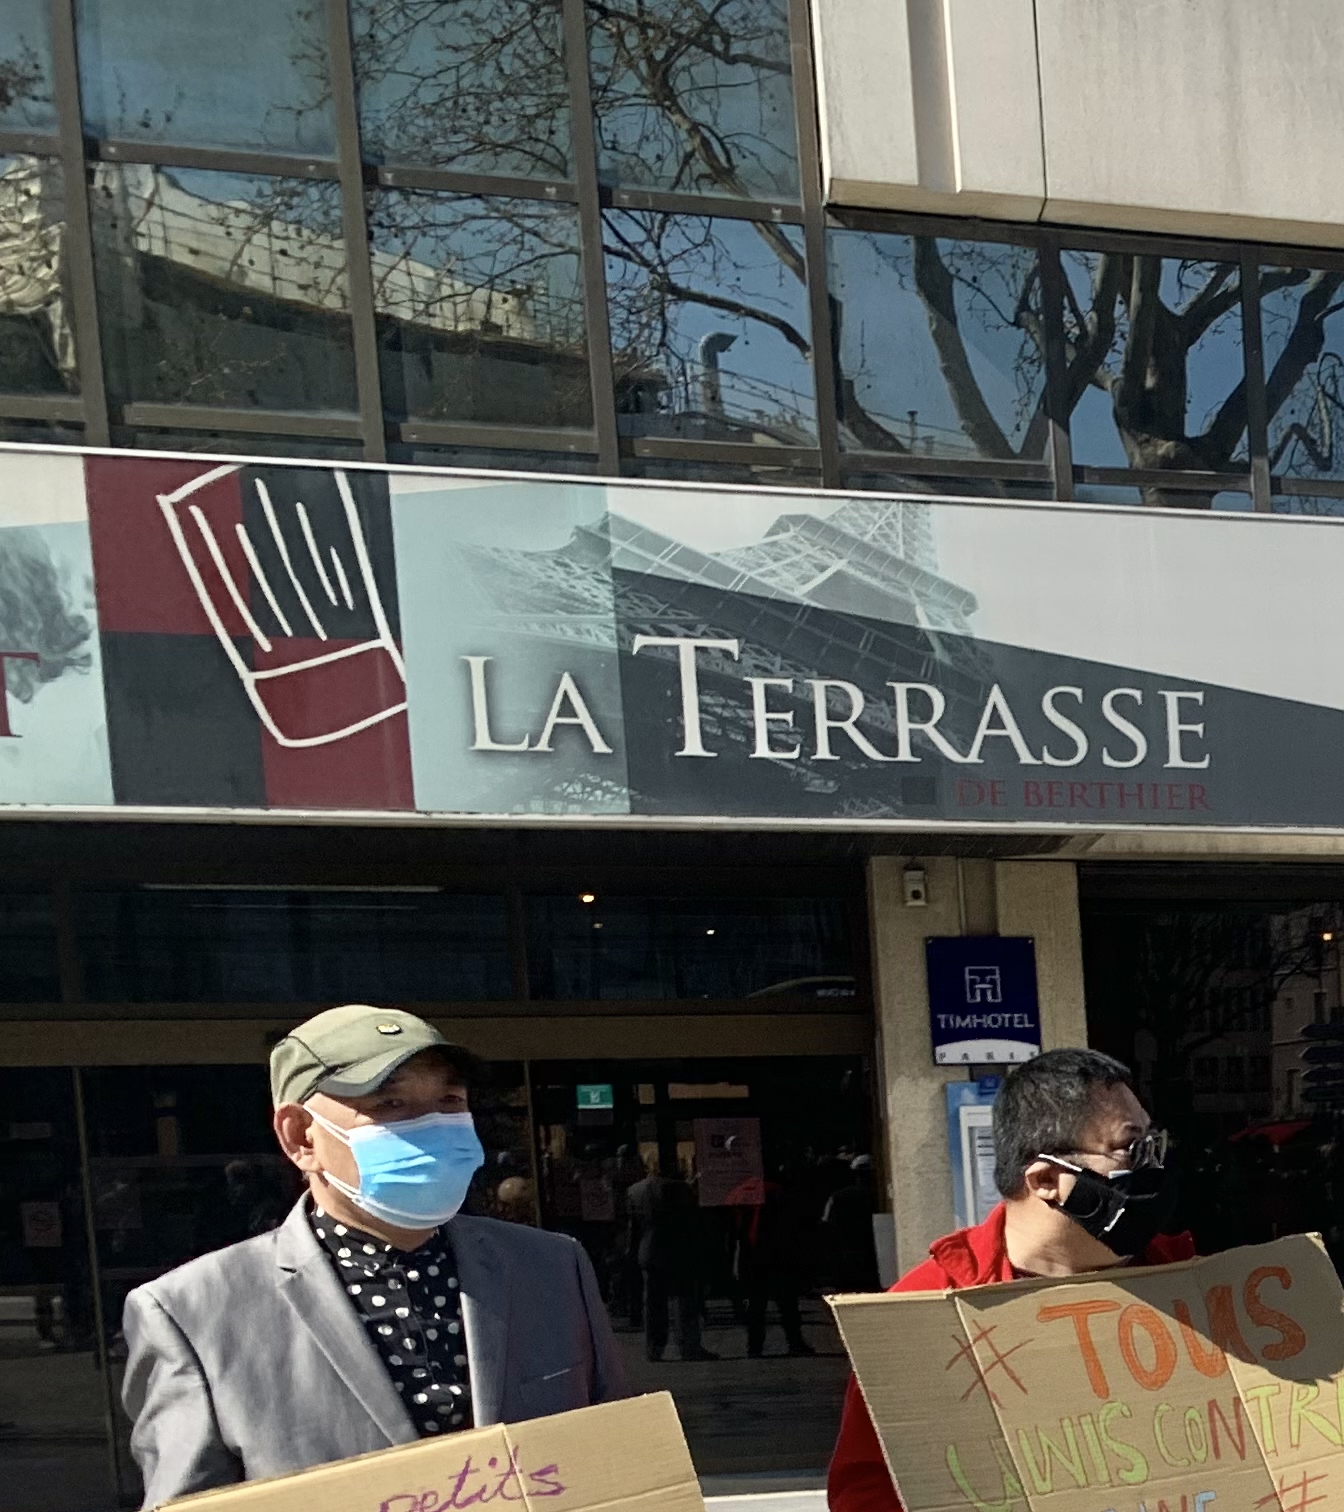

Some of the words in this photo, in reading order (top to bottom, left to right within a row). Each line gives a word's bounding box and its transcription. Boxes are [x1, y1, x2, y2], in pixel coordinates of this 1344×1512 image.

[460, 655, 612, 753] LA
[632, 634, 1210, 770] TERRASSE
[956, 780, 1008, 806] DE
[1024, 781, 1213, 811] BERTHIER
[937, 1013, 1035, 1029] TIMHOTEL
[1037, 1265, 1306, 1400] TOUS
